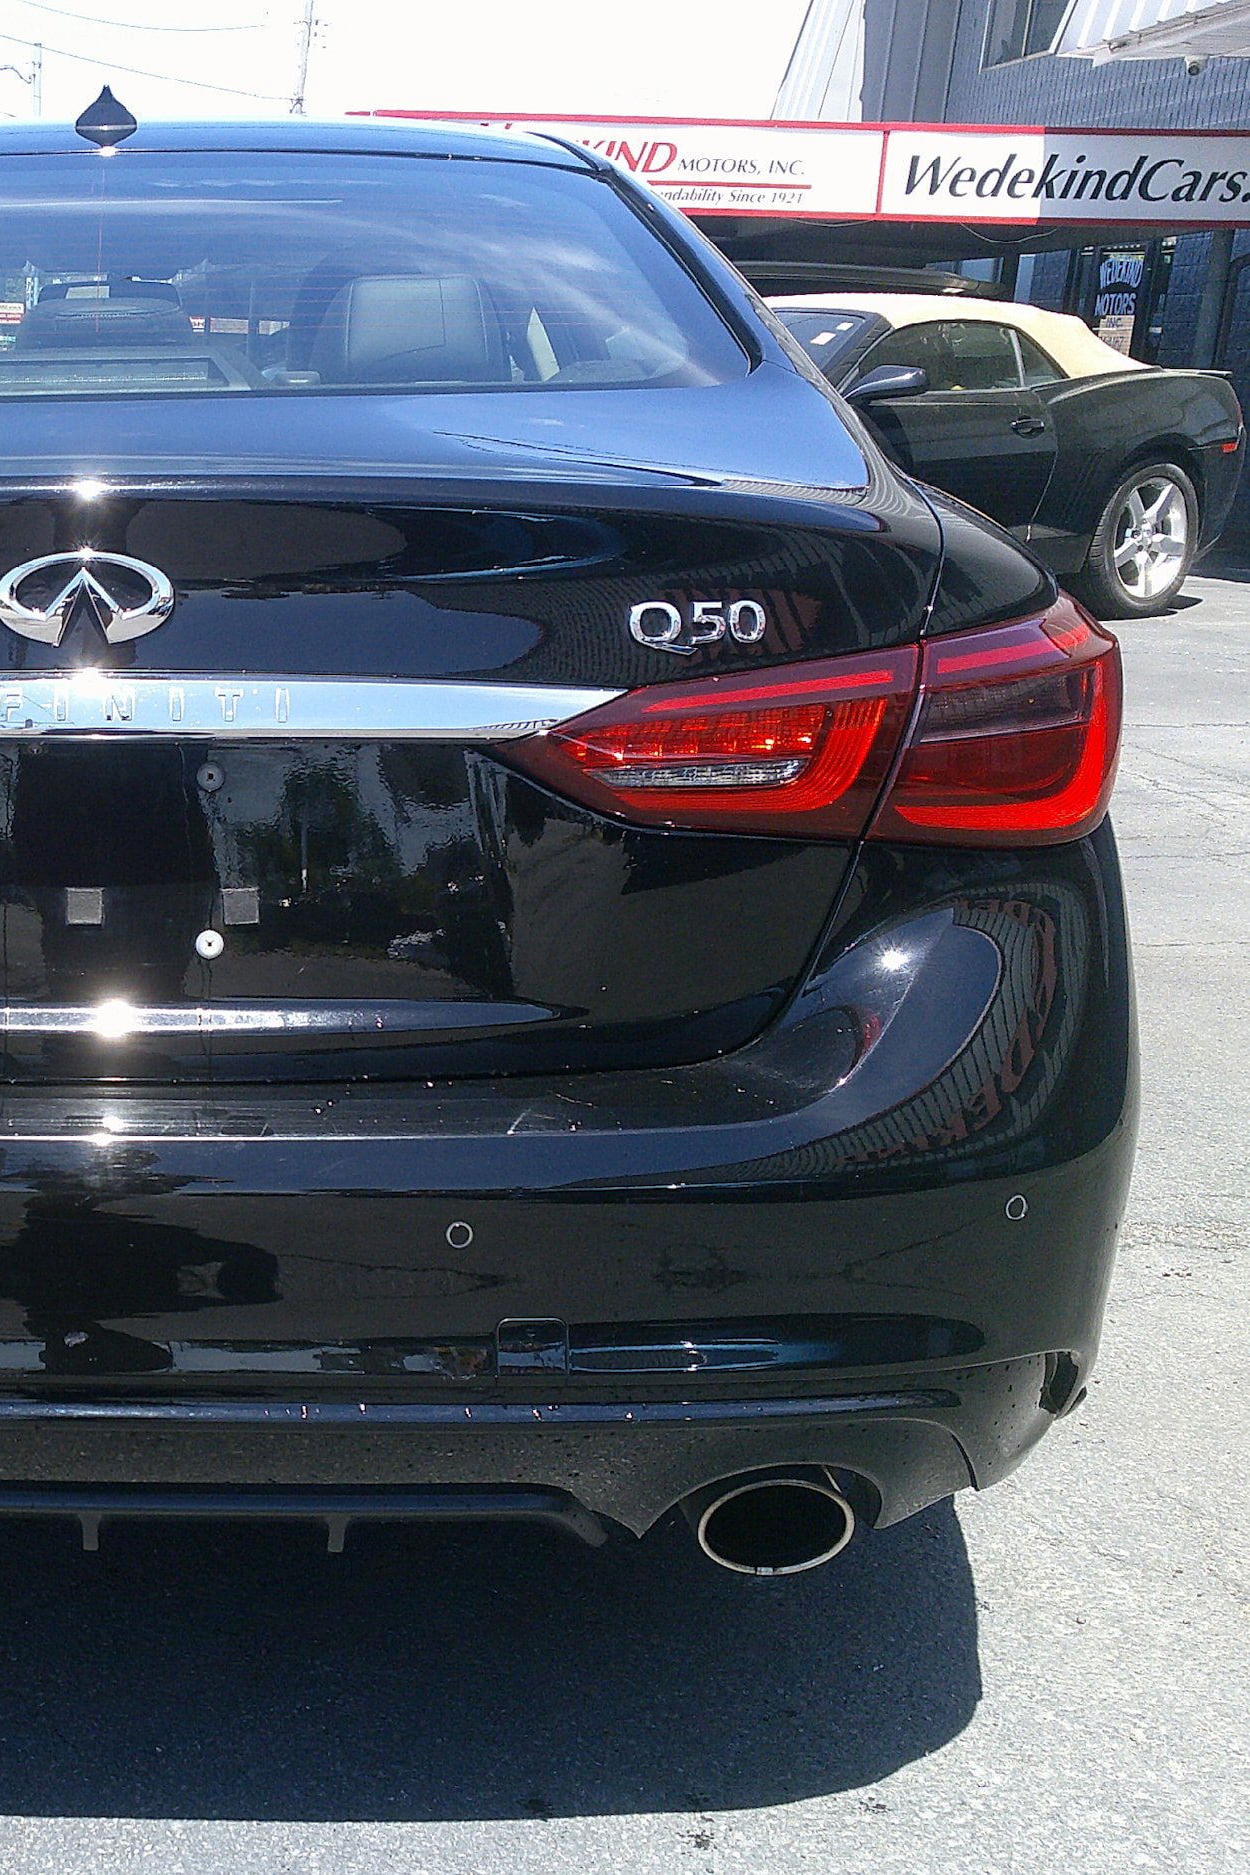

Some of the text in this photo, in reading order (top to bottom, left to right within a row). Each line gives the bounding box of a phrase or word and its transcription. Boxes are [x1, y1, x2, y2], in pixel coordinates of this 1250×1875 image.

[677, 157, 762, 176] MOTORS,
[768, 159, 805, 176] INC.
[904, 153, 1250, 203] WedekindCars.
[659, 187, 803, 206] ndability Since 1921
[1094, 293, 1137, 316] MOTORS
[629, 599, 767, 656] Q50
